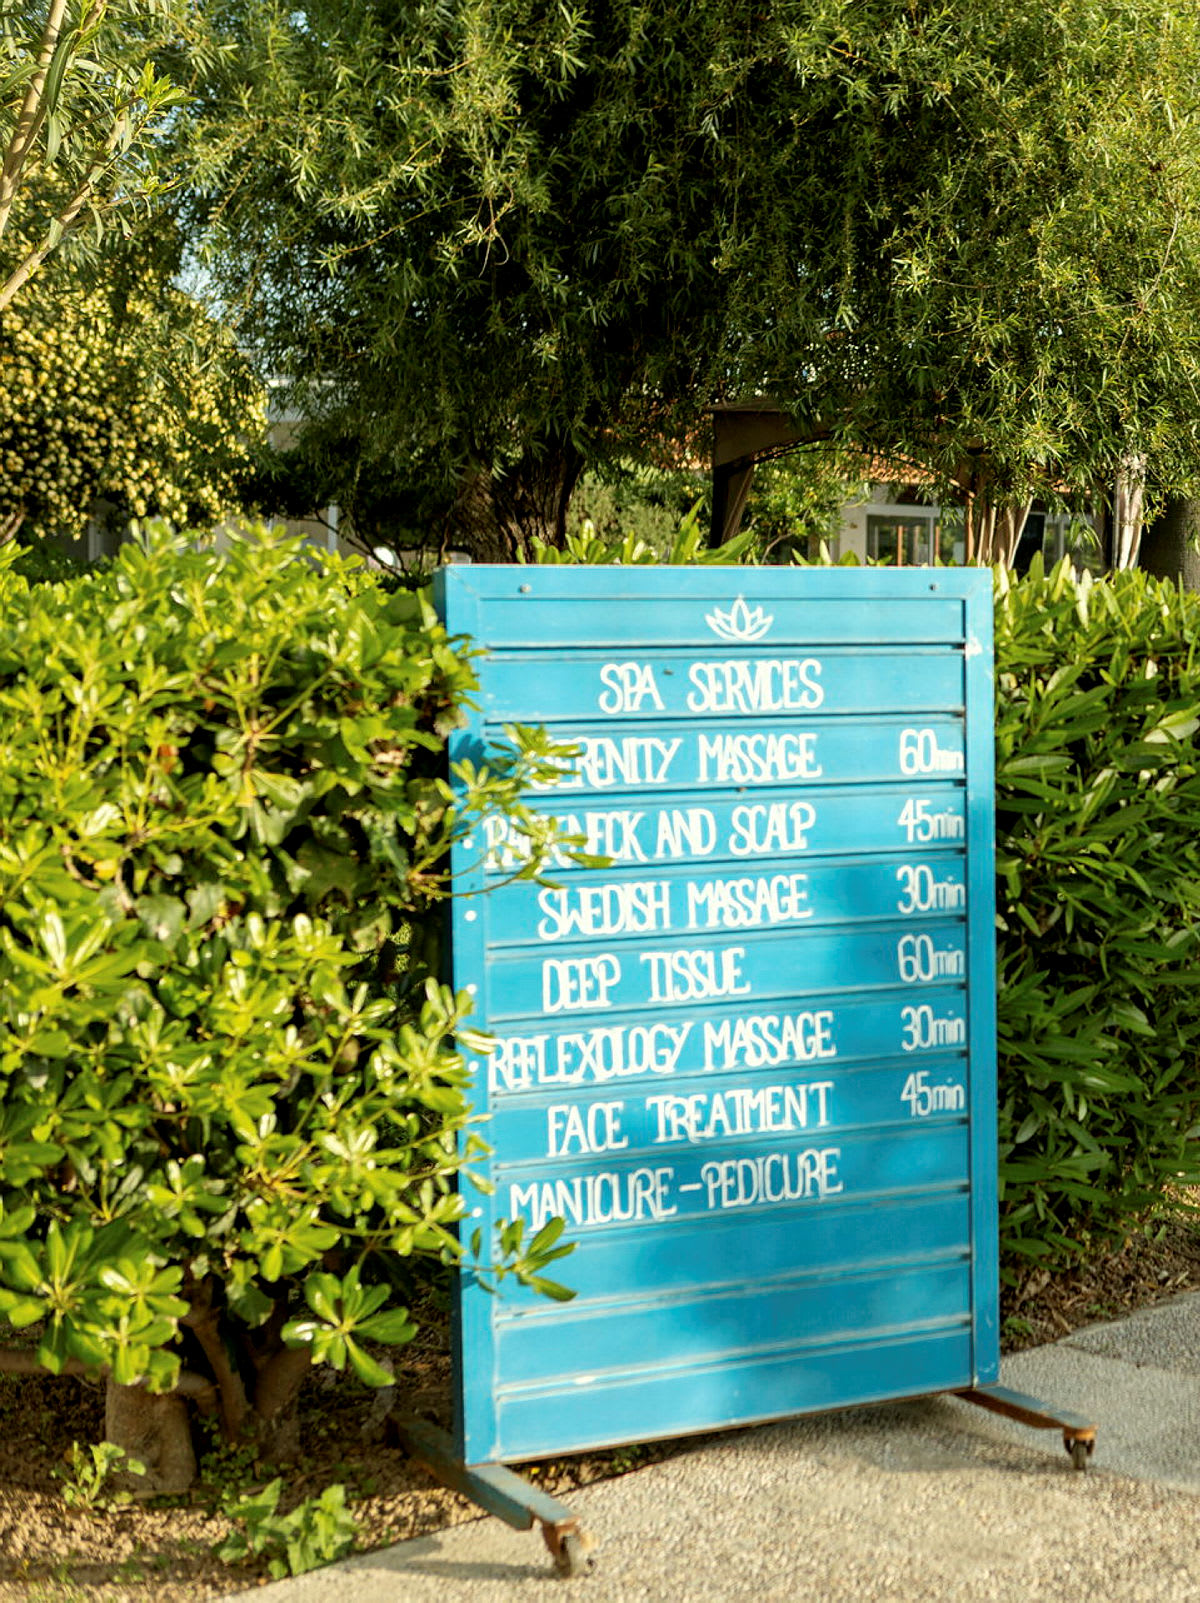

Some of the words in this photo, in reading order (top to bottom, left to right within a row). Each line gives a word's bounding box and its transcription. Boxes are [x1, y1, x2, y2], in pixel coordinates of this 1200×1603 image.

[599, 661, 666, 714] SPA
[686, 658, 825, 713] SERVICES
[697, 732, 823, 784] MASSAGE
[655, 807, 717, 858] AND
[728, 801, 816, 857] SCALP
[897, 798, 965, 843] 45min
[537, 880, 670, 941] SWEDISH
[687, 873, 814, 929] MASSAGE
[896, 864, 966, 914] 30min
[541, 953, 622, 1014] DEEP
[640, 947, 752, 1003] TISSUE
[897, 934, 965, 983] 60min
[488, 1021, 695, 1093] REFLEXOLOGY
[703, 1010, 837, 1072] MASSAGE
[900, 1004, 966, 1052] 30min
[546, 1101, 629, 1158] FACE
[645, 1081, 834, 1145] TREATMENT
[900, 1070, 965, 1117] 45min
